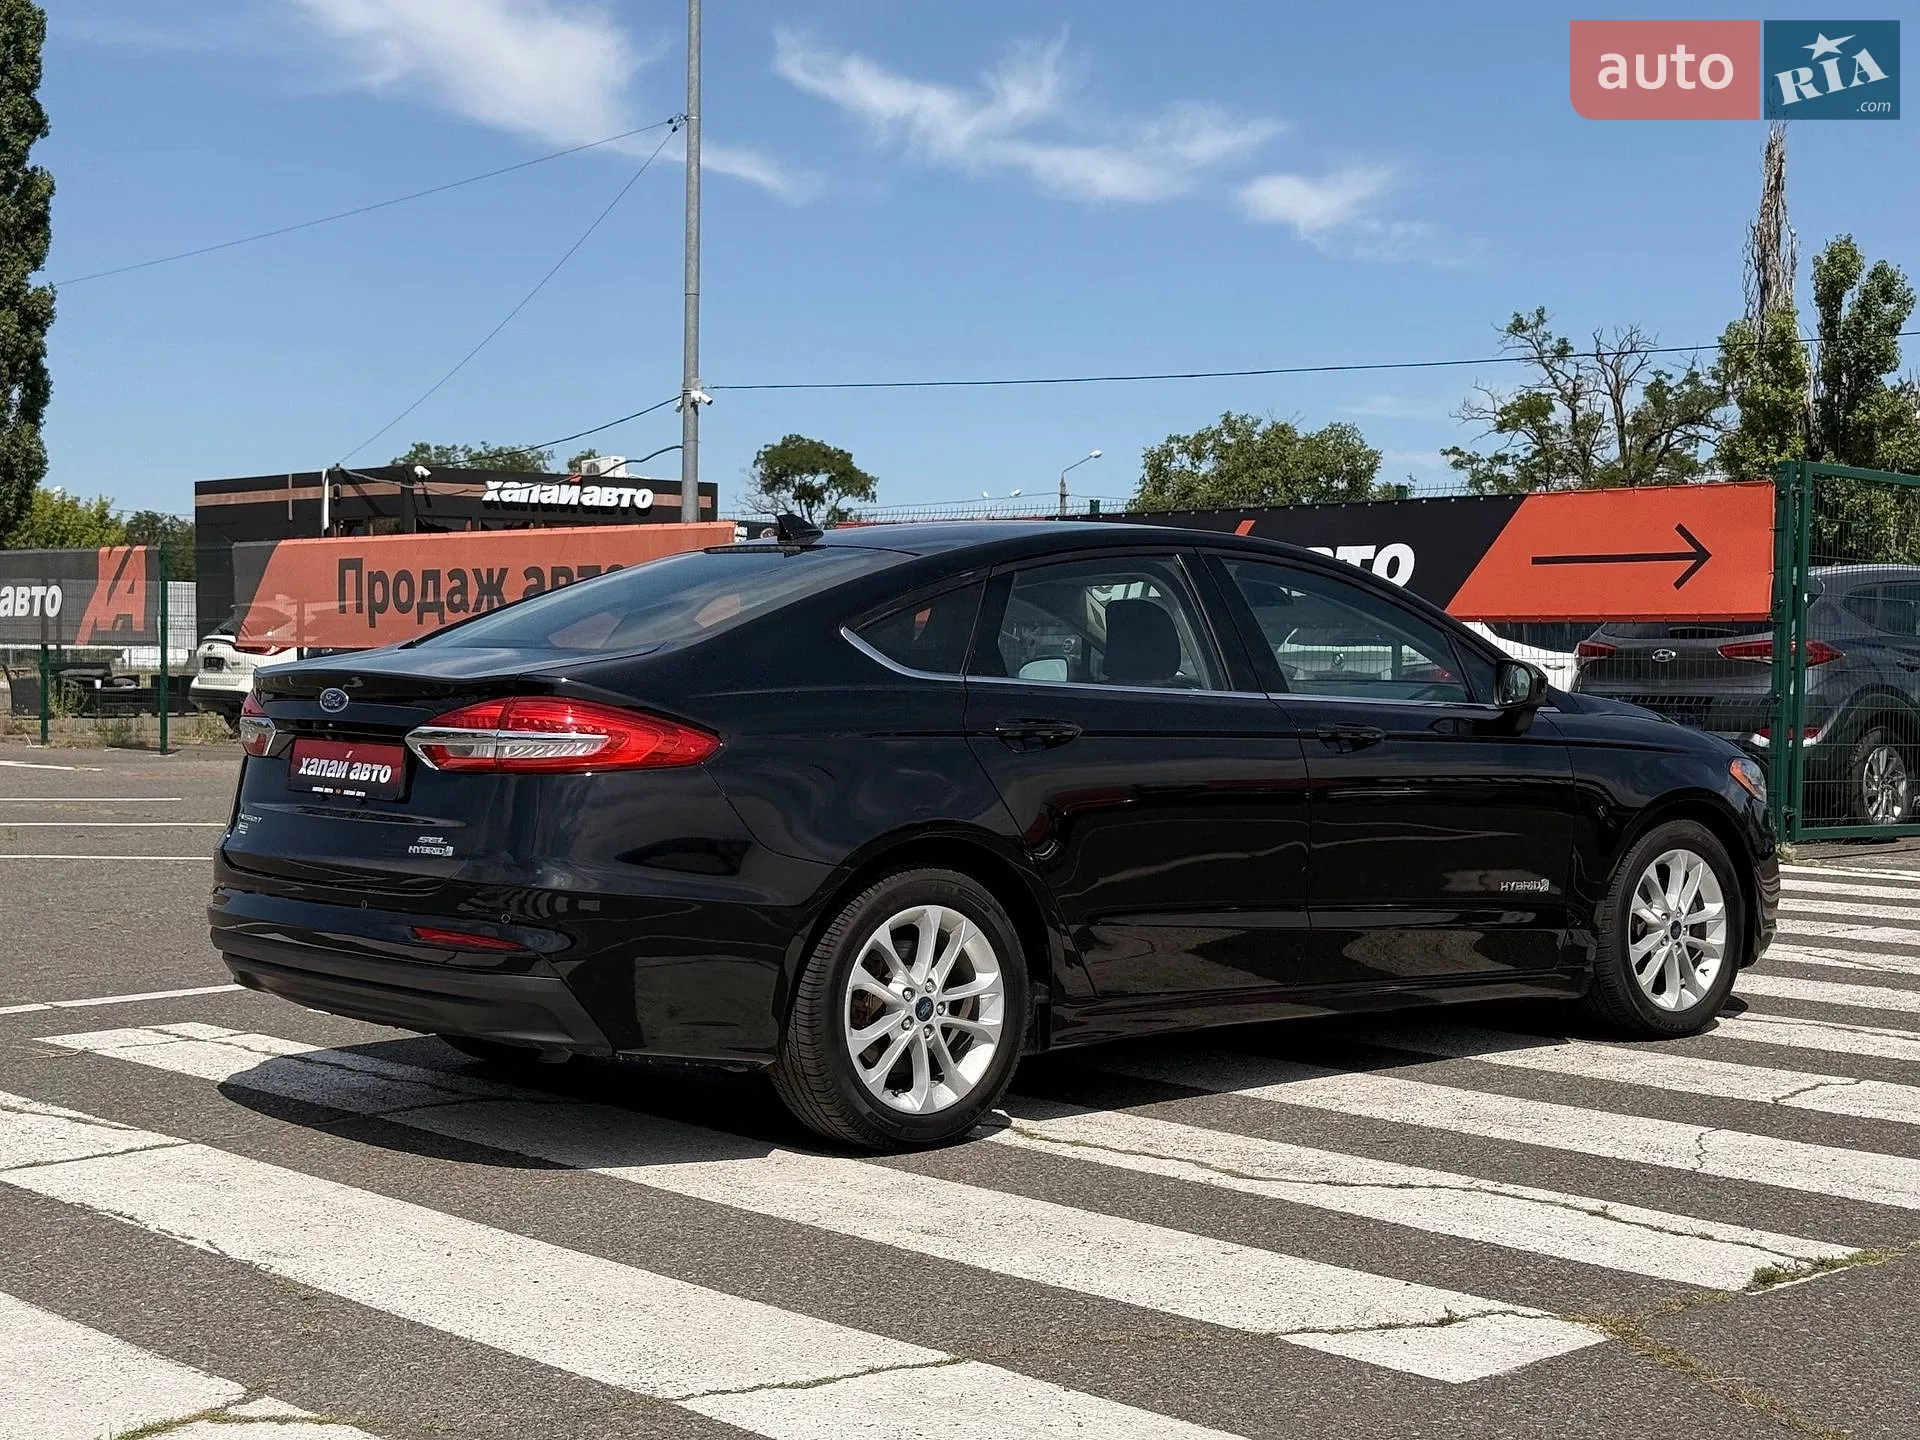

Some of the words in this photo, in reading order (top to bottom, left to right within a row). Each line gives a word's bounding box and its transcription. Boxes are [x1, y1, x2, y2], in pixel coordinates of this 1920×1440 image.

[338, 557, 509, 628] Продаж
[408, 845, 445, 855] HYBRID
[1500, 880, 1541, 892] HYBRID
